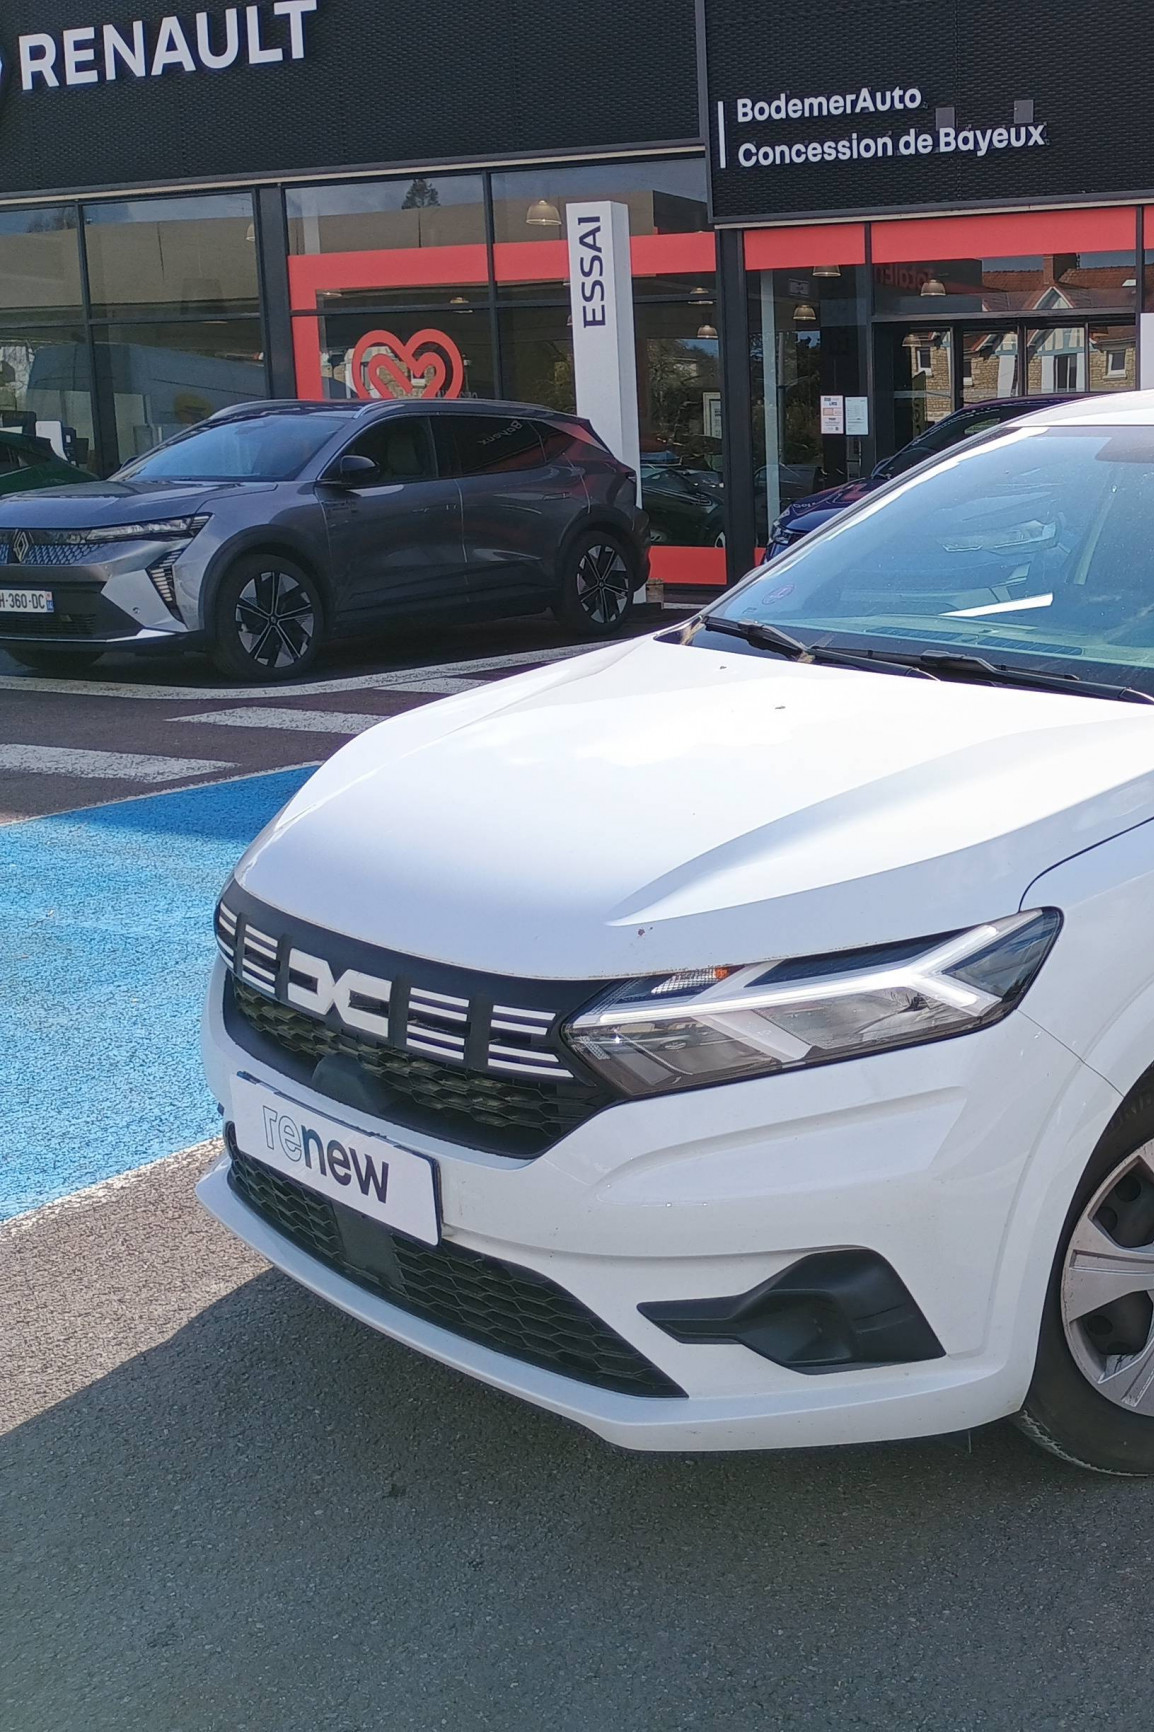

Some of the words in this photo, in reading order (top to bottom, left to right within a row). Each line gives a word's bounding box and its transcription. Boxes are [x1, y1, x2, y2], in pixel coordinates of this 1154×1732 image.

[18, 0, 318, 91] RENAULT
[737, 86, 922, 123] BodemerAuto
[738, 132, 893, 168] Concession
[898, 128, 933, 156] de
[938, 124, 1046, 157] Bayeux
[577, 215, 606, 329] ESSAI
[262, 1104, 389, 1204] renew
